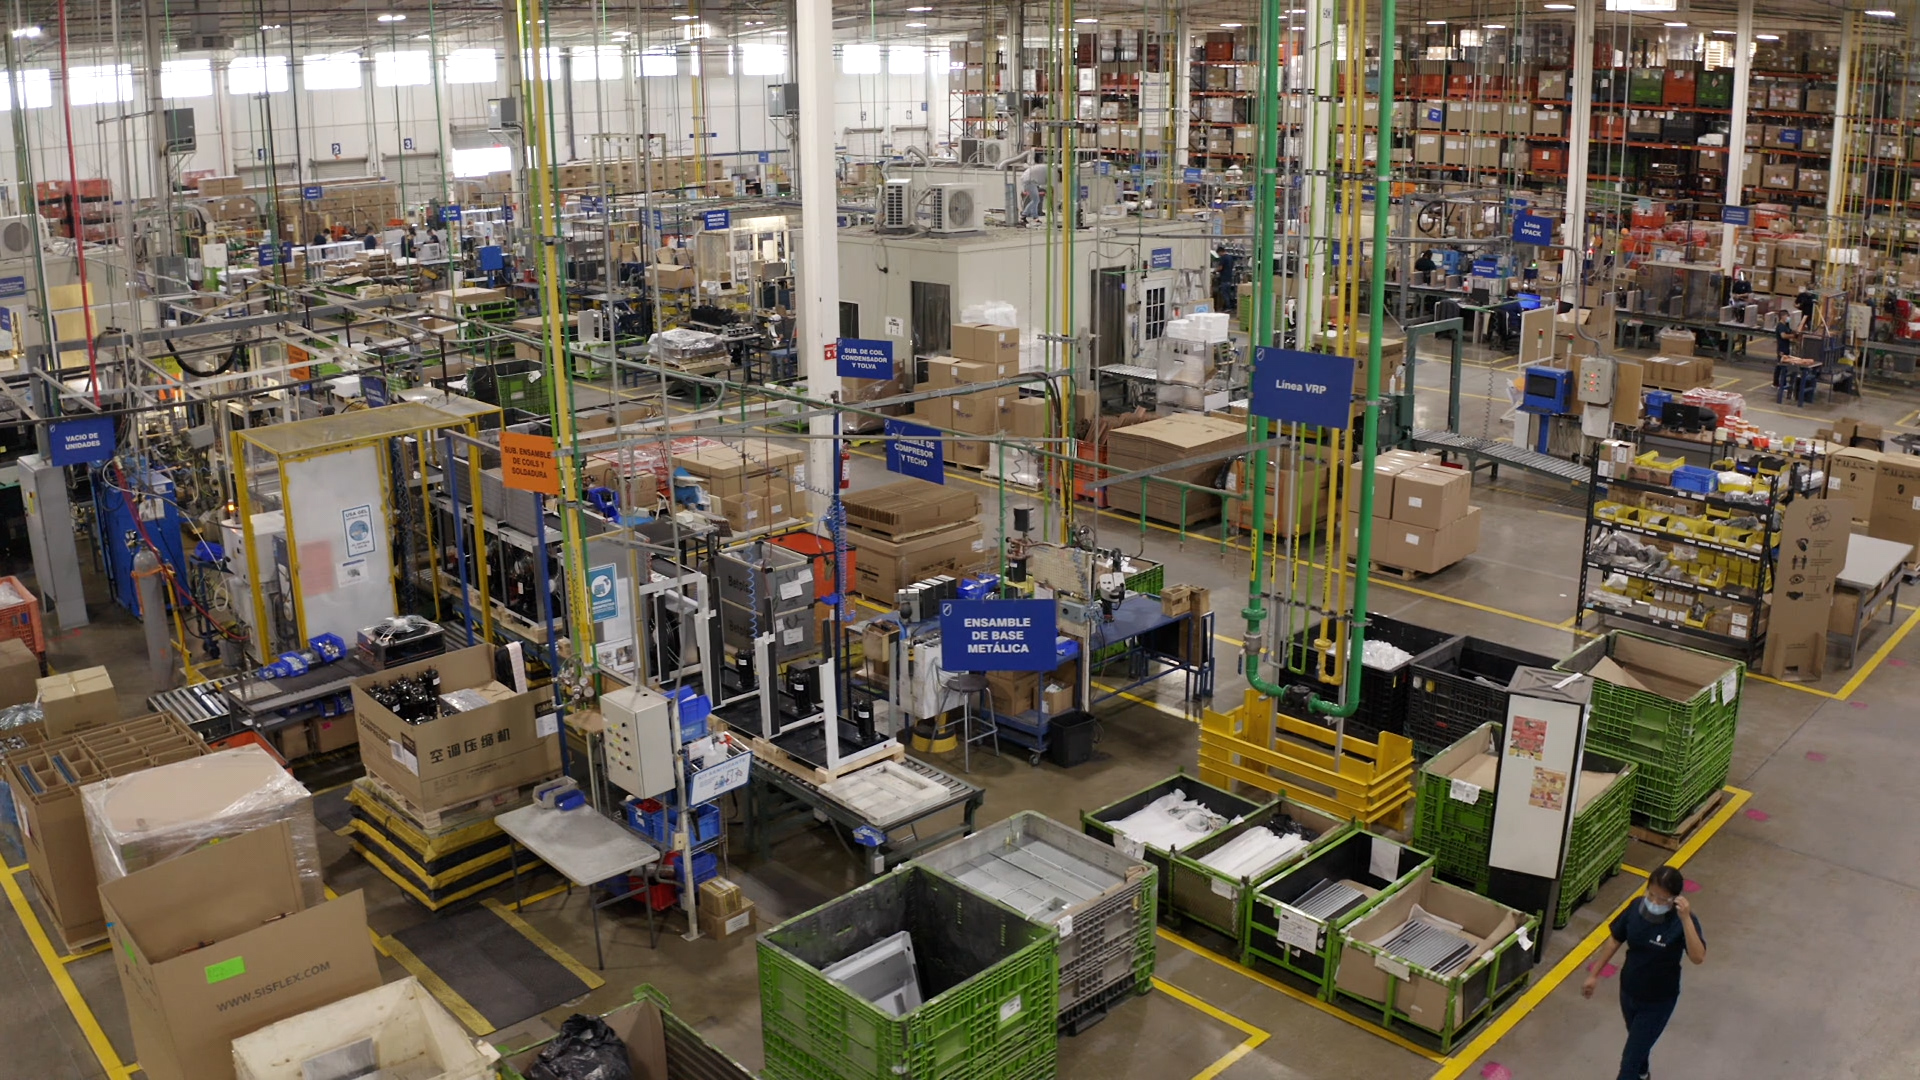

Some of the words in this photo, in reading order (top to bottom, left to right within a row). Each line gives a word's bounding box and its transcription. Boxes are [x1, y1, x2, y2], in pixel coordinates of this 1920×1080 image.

[333, 144, 341, 155] 2
[405, 139, 412, 149] 3
[1521, 228, 1542, 237] VPACK
[841, 354, 888, 363] CONDENSADOR
[1275, 379, 1303, 392] Línea
[1305, 383, 1327, 394] VRP
[65, 433, 87, 443] VACIO
[88, 432, 99, 440] DE
[65, 440, 100, 450] UNIDADES
[926, 440, 935, 449] DE
[504, 446, 518, 454] SUB.
[519, 447, 551, 459] ENSAMBLE
[894, 443, 934, 459] COMPRESOR
[521, 458, 539, 468] COILS
[906, 455, 928, 467] TECHO
[511, 467, 548, 479] SOLDADURA
[964, 617, 1031, 628] ENSAMBLE
[971, 631, 989, 640] DE
[991, 630, 1024, 640] BASE
[967, 641, 1030, 653] METÁLICA
[429, 727, 511, 764] 空调压缩机
[216, 961, 331, 1012] WWW.SISFLEX.COM
